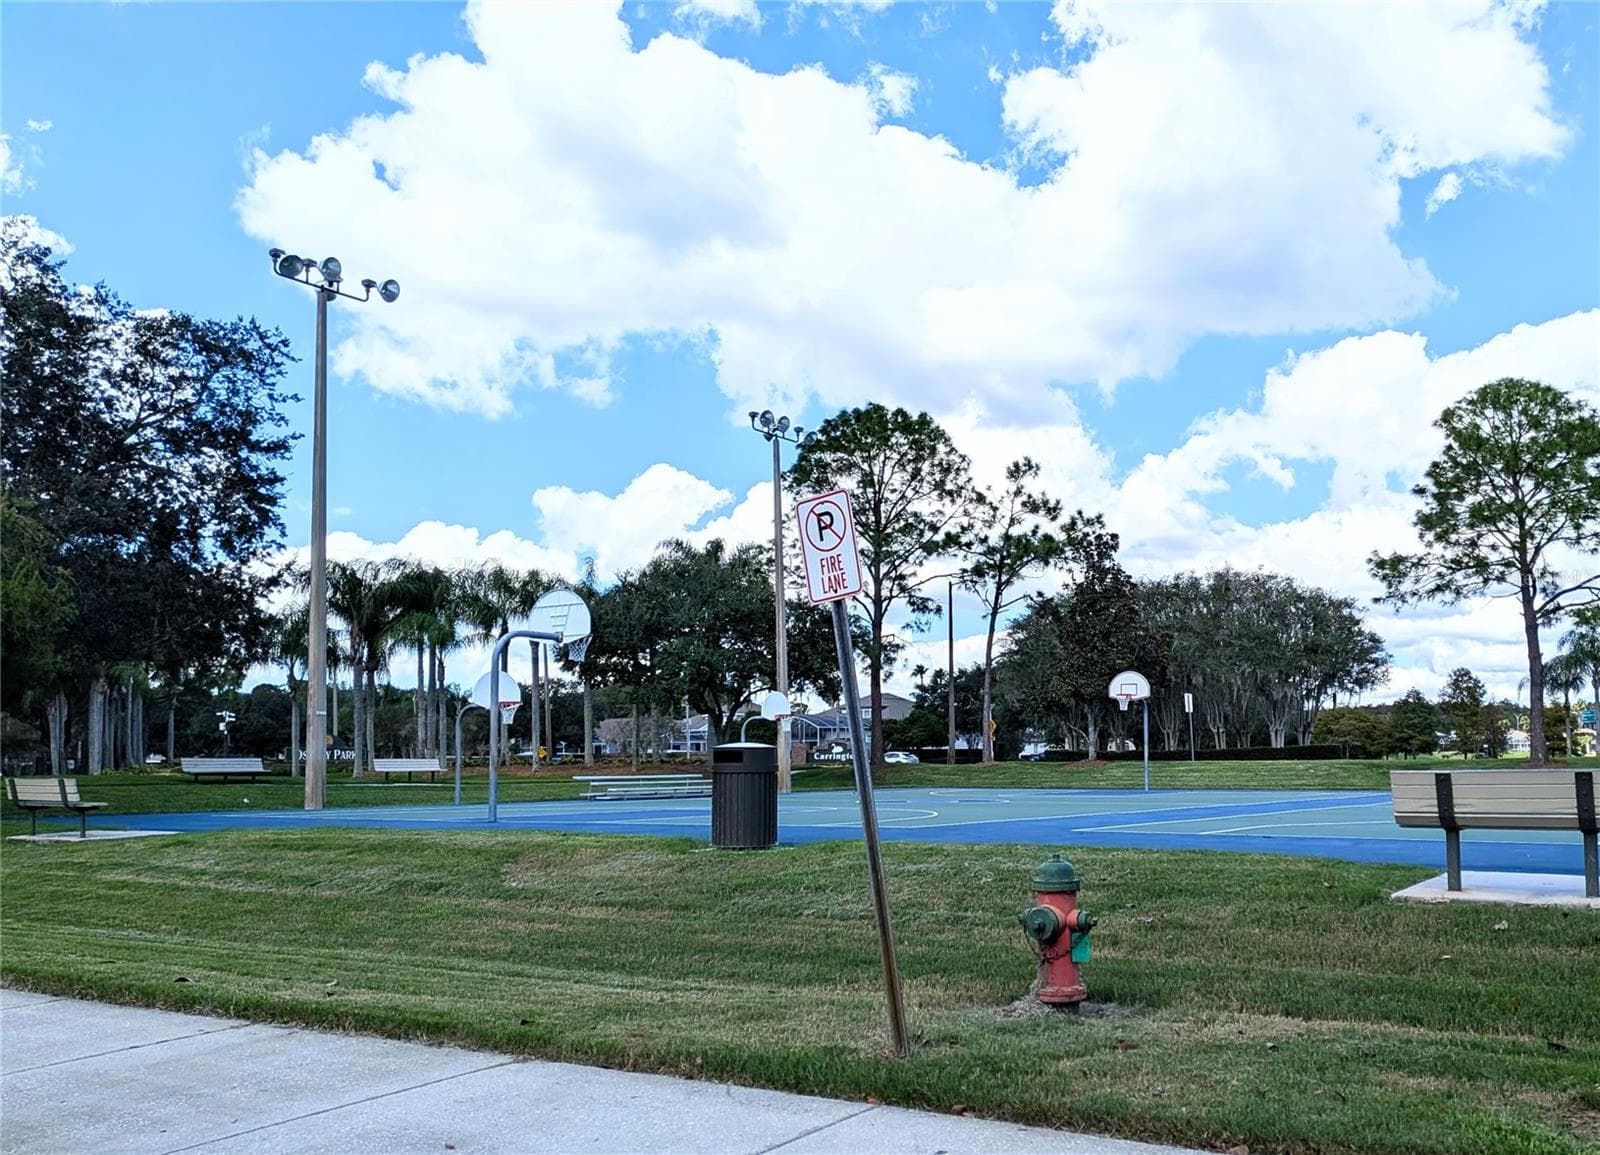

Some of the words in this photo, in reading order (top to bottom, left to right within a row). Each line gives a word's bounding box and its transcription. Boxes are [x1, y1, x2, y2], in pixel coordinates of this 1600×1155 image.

[817, 511, 834, 542] P
[820, 554, 844, 576] FIRE
[821, 572, 848, 594] LANE
